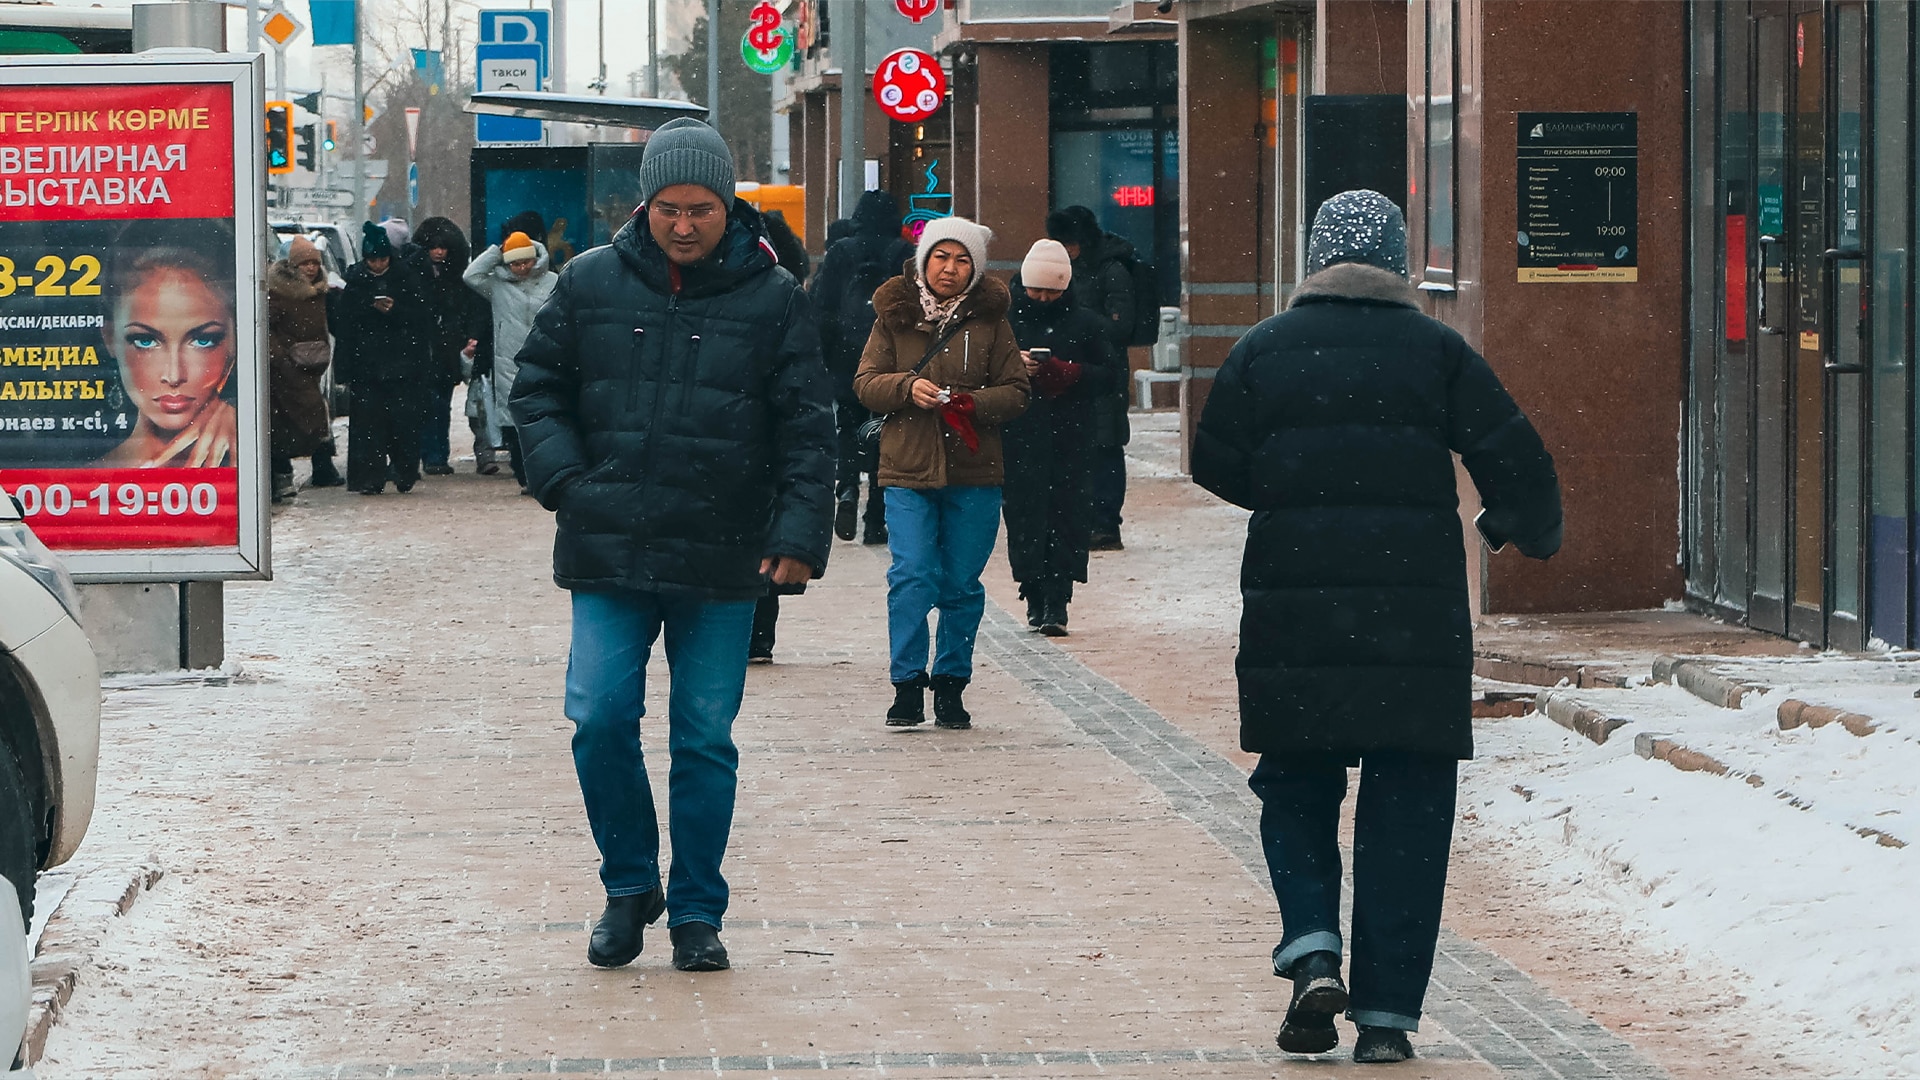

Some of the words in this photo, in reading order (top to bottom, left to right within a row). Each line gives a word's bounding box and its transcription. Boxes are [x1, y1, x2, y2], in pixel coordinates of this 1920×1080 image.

[108, 107, 210, 131] КӨРМЕ
[0, 144, 187, 174] ВЕЛИРНАЯ
[1594, 166, 1626, 177] 09:00
[0, 177, 171, 207] ЫСТАВКА
[1596, 225, 1626, 236] 19:00
[0, 345, 99, 371] МЕДИА
[115, 413, 128, 430] 4
